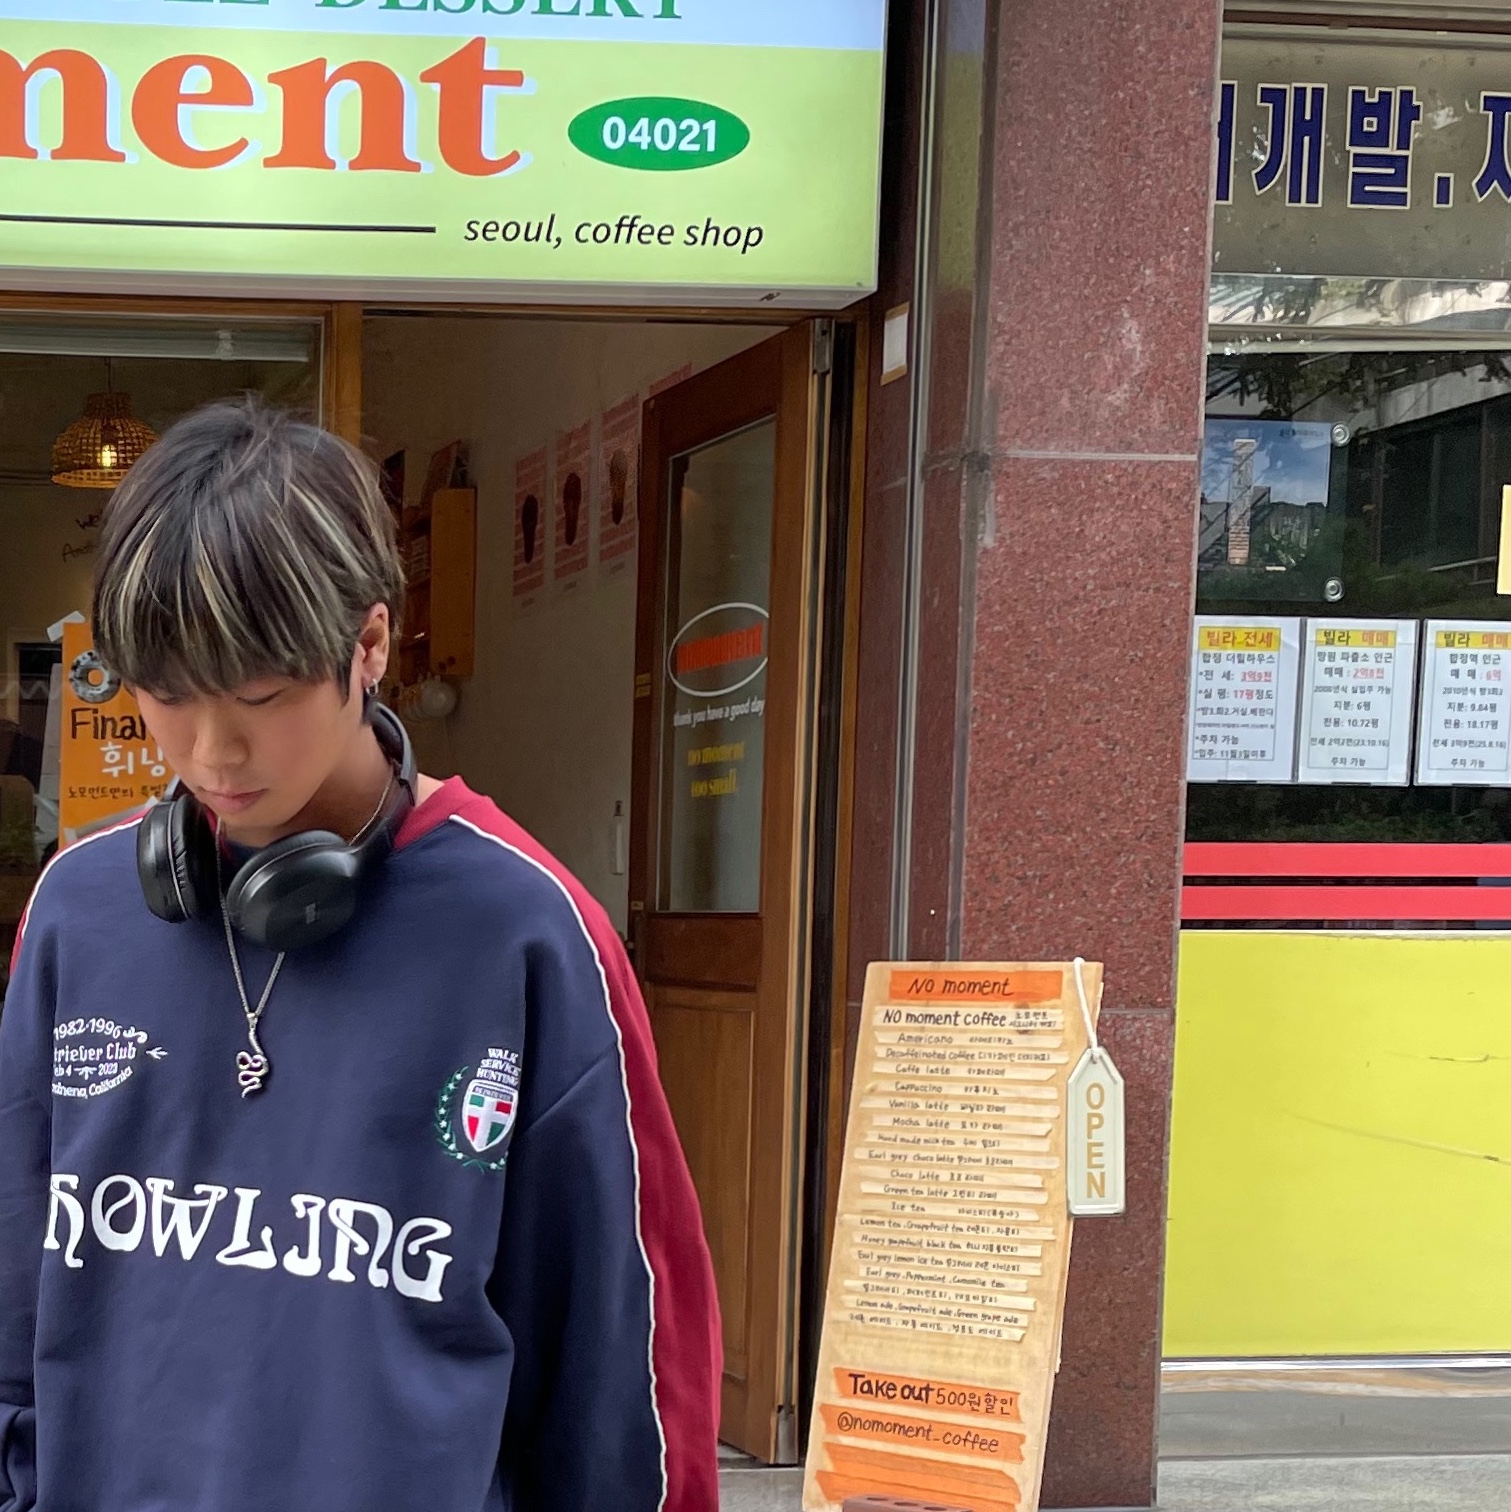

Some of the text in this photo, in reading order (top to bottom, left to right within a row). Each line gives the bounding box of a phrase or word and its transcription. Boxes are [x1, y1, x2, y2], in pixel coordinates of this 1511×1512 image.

[601, 116, 717, 153] 04021
[464, 214, 764, 255] seoul, coffee shop
[1207, 631, 1273, 648] 빌라 전세
[1324, 631, 1389, 646] 빌라 매매
[1444, 633, 1508, 648] 빌라 매매
[941, 976, 1015, 996] moment
[883, 1009, 1007, 1027] NO moment coffee
[898, 1033, 954, 1044] Americano
[107, 1042, 136, 1060] Club
[488, 1047, 519, 1064] WALK
[889, 1099, 920, 1109] Vanilla
[925, 1100, 949, 1111] latte
[892, 1117, 920, 1127] Mocha
[926, 1119, 950, 1129] latte
[1085, 1082, 1105, 1199] OPEN
[848, 1373, 1014, 1416] Take out 500원 할인
[838, 1411, 999, 1453] @nomoment_coffee
